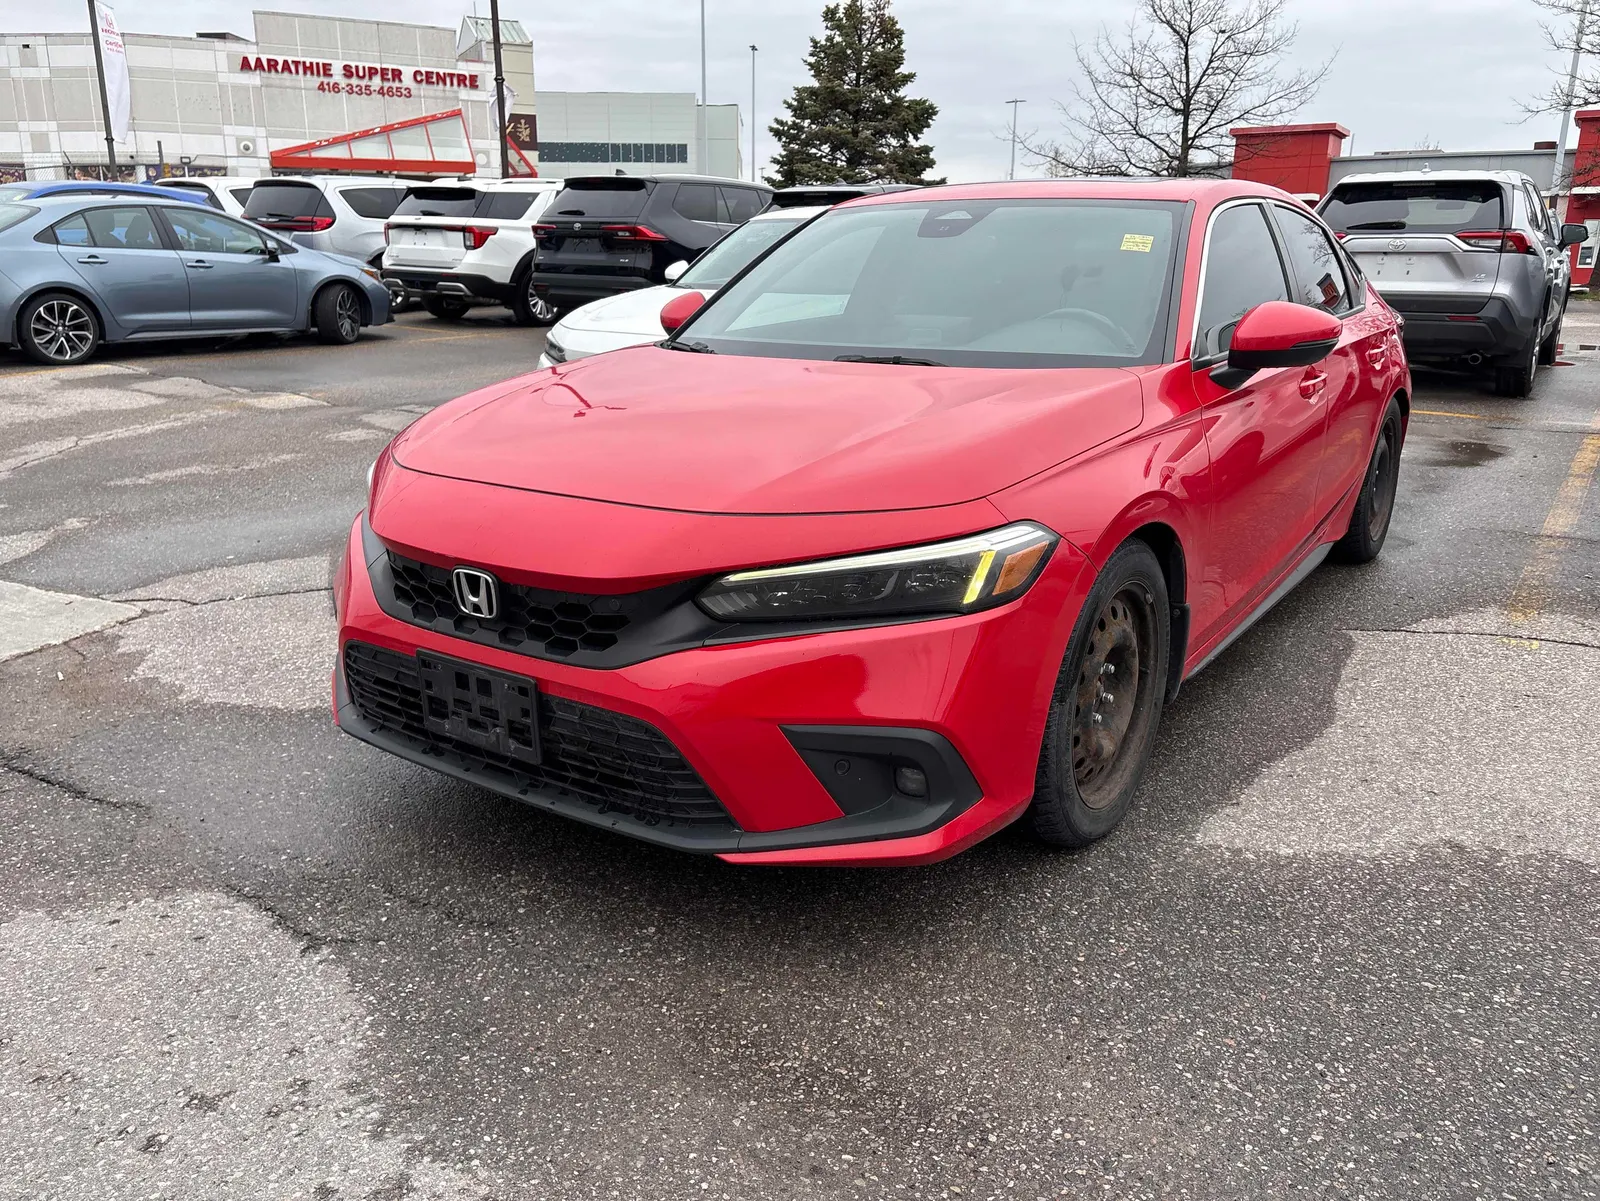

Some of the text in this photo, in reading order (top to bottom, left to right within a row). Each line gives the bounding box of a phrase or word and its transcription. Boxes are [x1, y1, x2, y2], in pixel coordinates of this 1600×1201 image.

[240, 56, 479, 90] AARATHIE SUPER CENTRE
[317, 81, 412, 98] 416-335-4653
